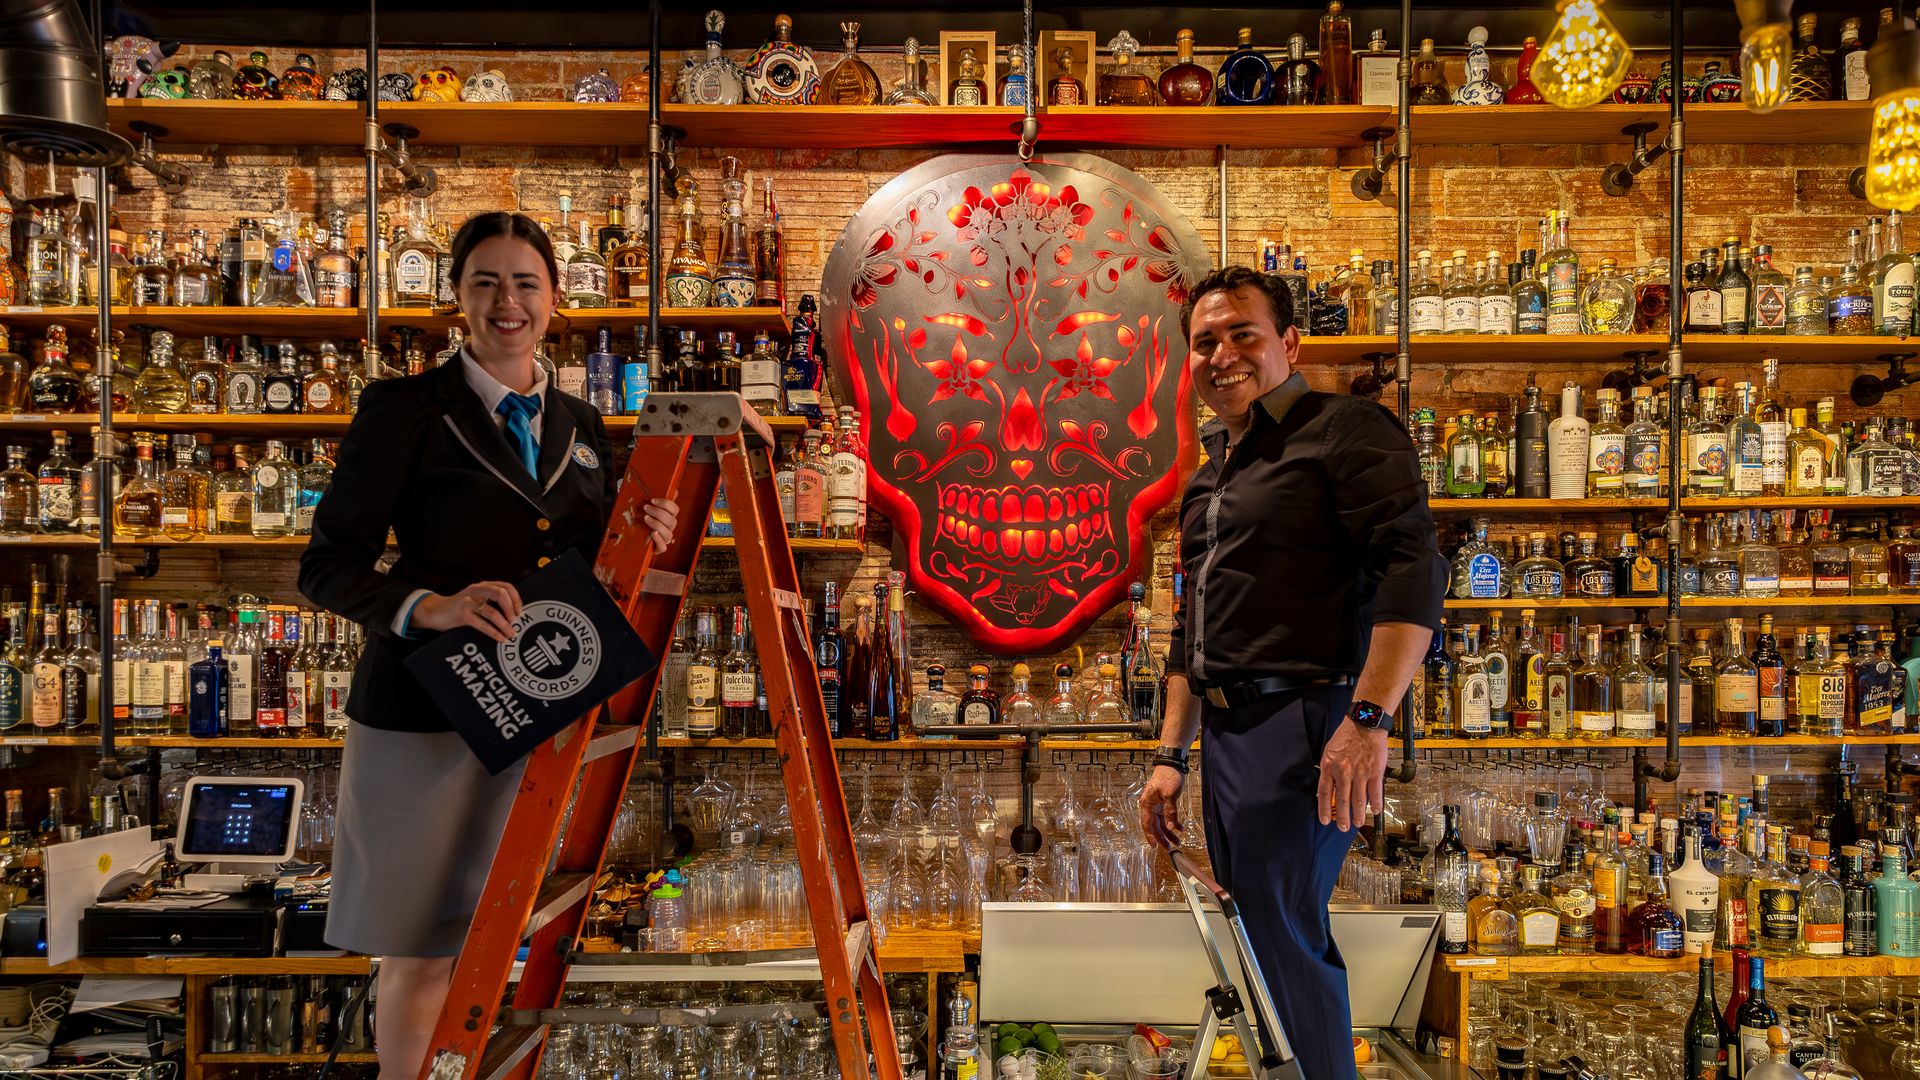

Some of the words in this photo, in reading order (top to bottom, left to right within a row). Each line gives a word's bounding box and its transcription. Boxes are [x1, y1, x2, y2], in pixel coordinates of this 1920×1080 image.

[546, 607, 594, 667] GUINNESS
[36, 677, 57, 689] G4
[463, 642, 534, 727] OFFICIALLY
[511, 666, 579, 694] RECORDS
[1489, 678, 1507, 686] RETTE
[1821, 677, 1844, 693] 818
[445, 654, 520, 741] AMAZING
[1864, 701, 1884, 711] 1953
